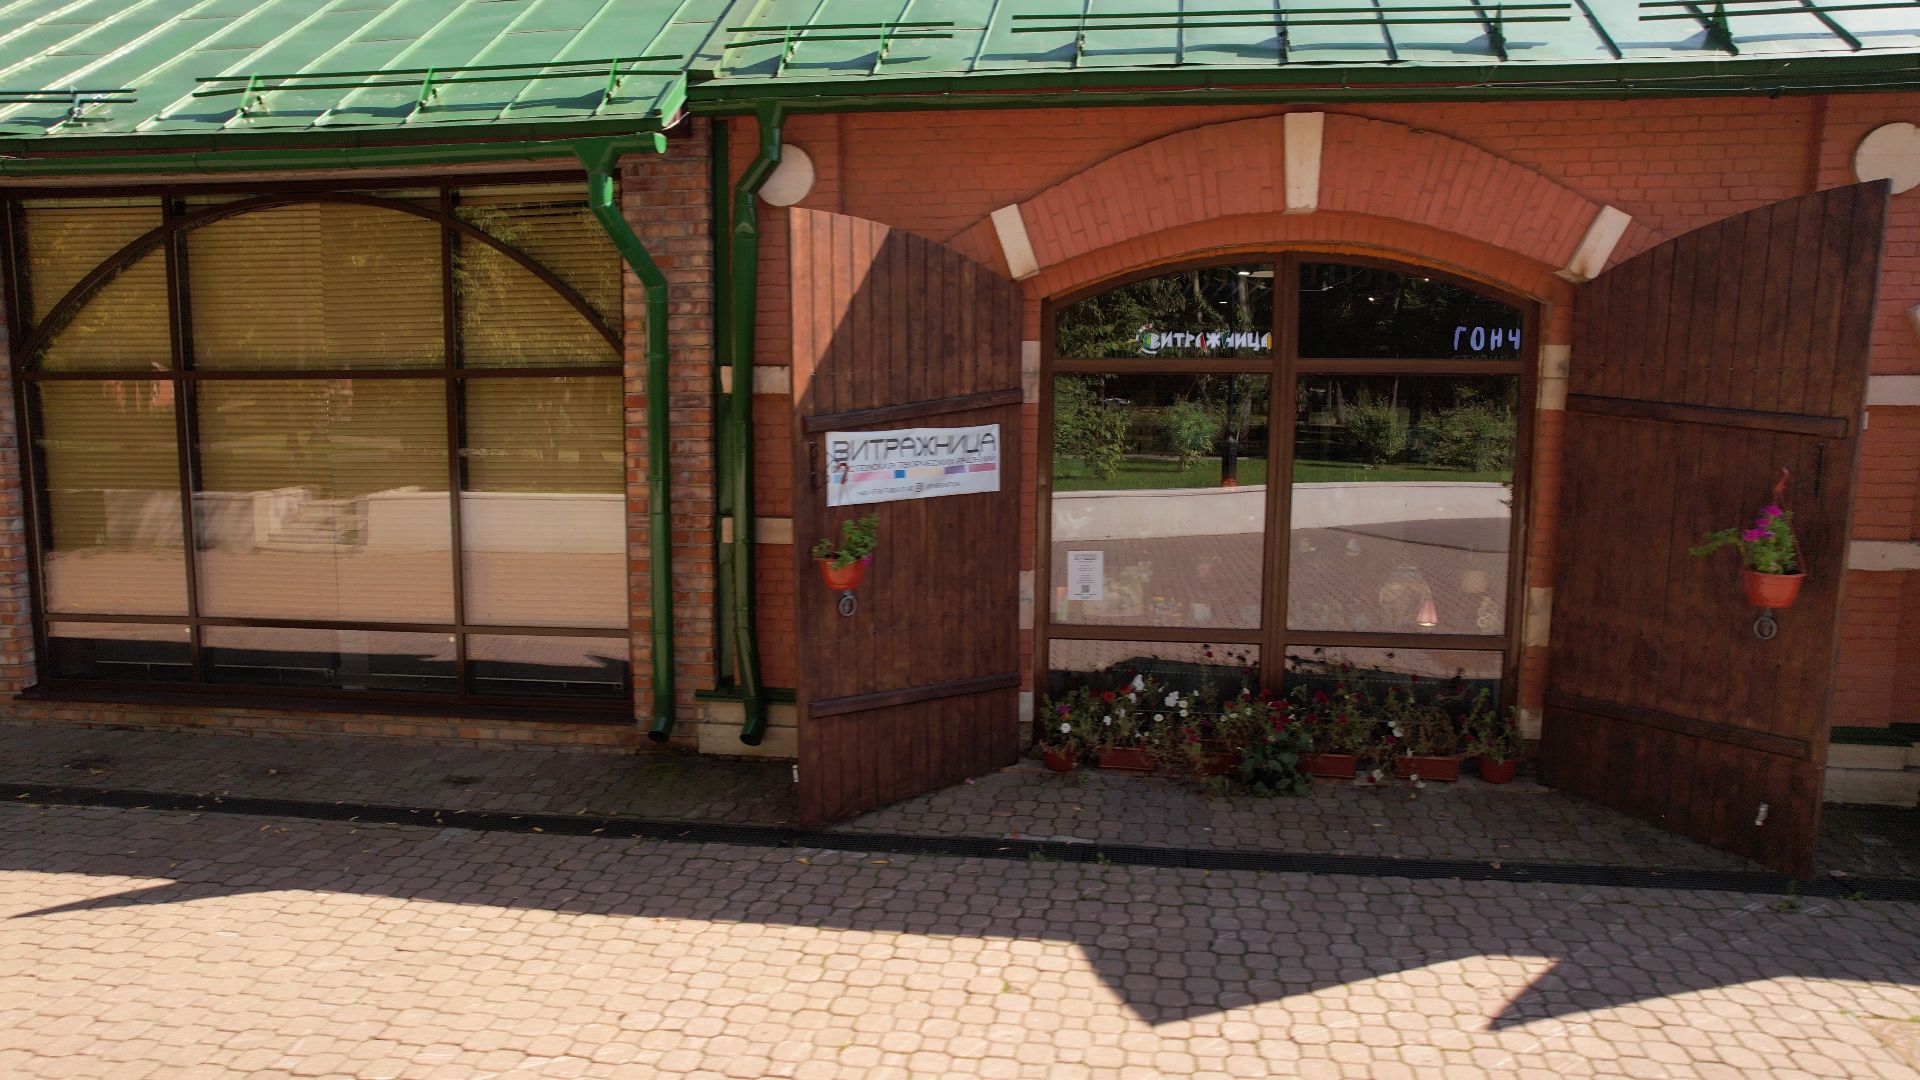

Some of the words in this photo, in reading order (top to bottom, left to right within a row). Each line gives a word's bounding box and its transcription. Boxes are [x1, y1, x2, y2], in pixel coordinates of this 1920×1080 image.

[1453, 326, 1521, 351] ГОНЧ
[832, 432, 997, 462] ВИТРАЖНИЦА
[831, 461, 894, 474] СТЕРСКАЯ
